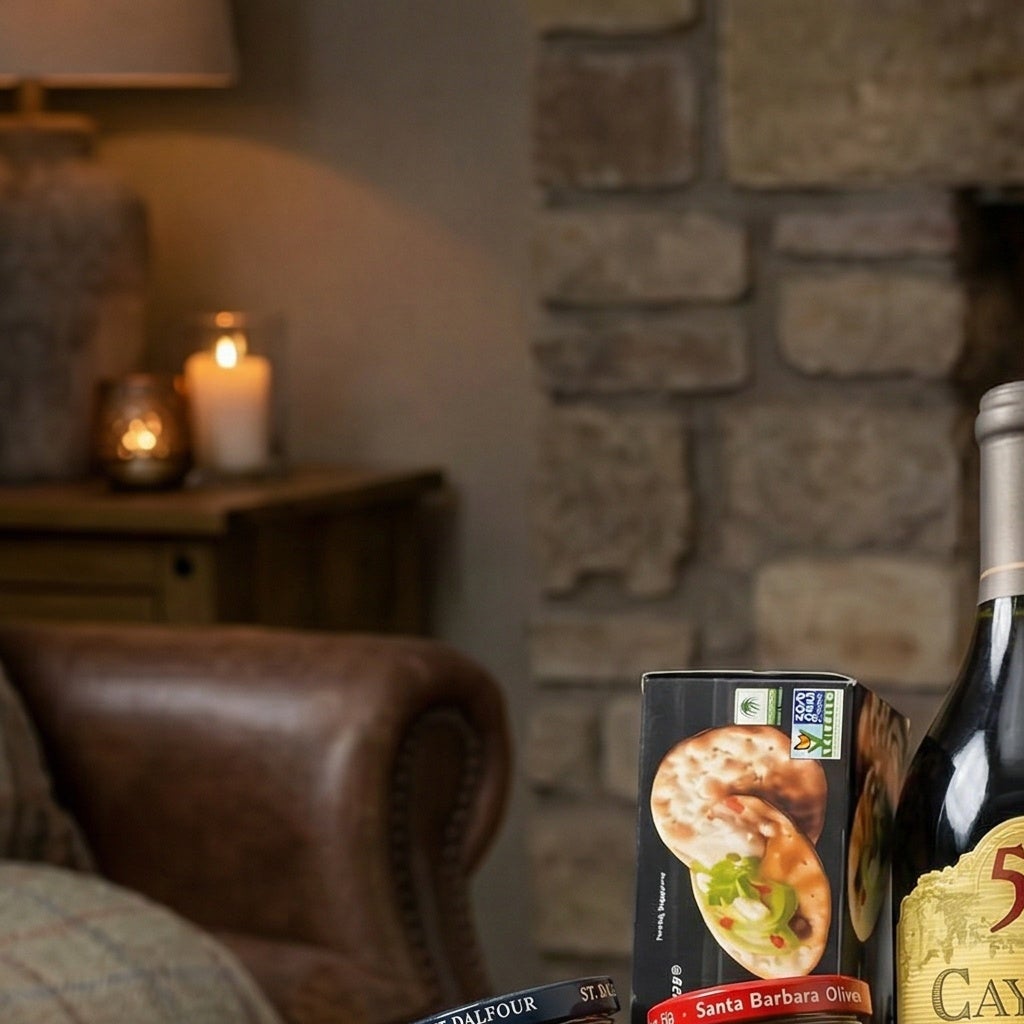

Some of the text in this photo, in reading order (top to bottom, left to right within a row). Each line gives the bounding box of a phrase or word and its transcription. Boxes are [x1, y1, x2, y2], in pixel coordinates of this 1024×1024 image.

[696, 986, 861, 1019] Santa Barbara Olive
